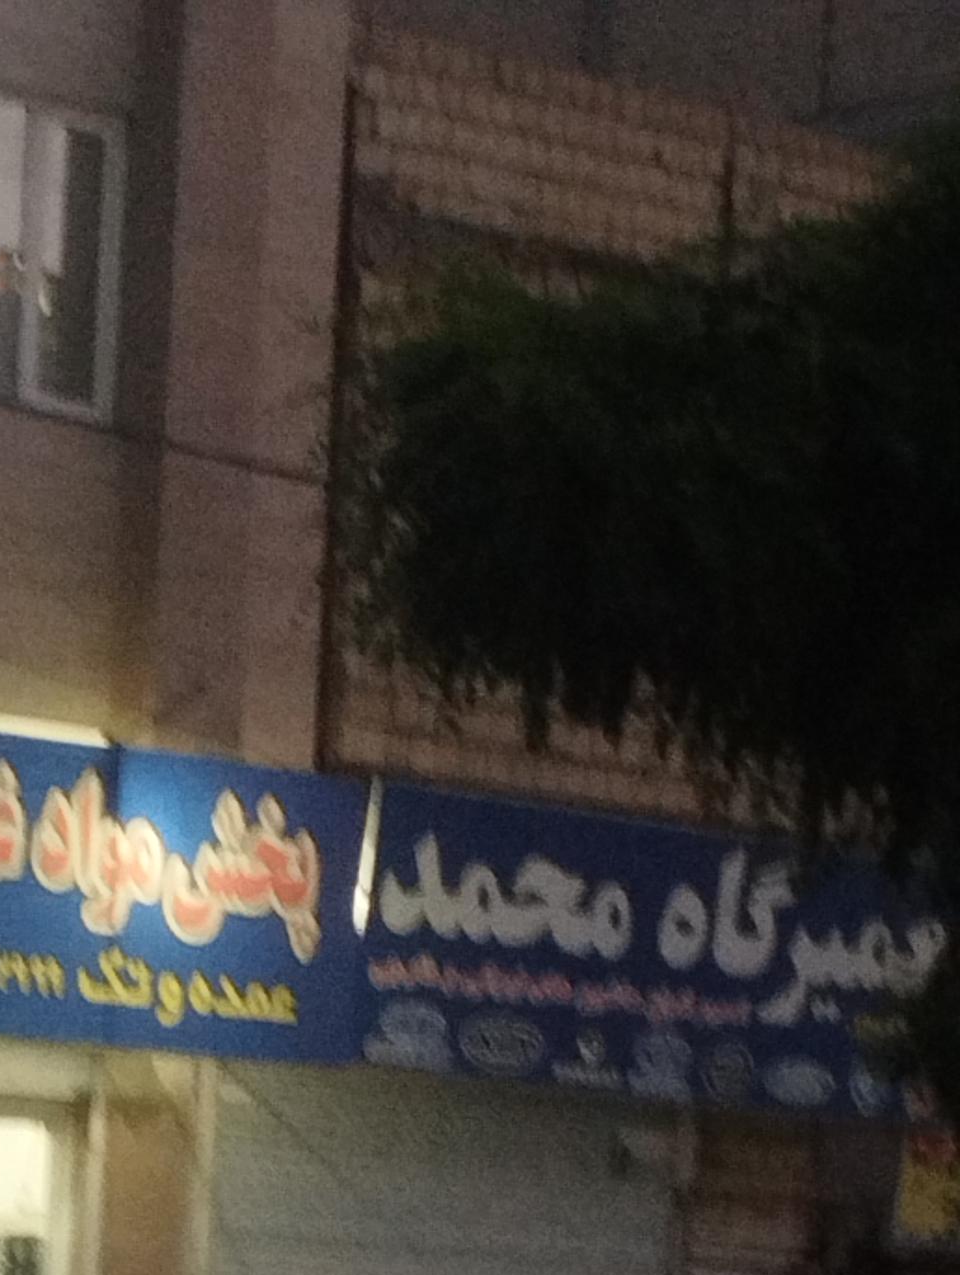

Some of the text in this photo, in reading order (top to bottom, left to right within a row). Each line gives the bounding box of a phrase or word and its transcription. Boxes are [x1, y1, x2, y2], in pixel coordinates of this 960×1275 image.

[32, 766, 167, 937] مواد
[161, 788, 323, 966] پخش
[377, 832, 633, 961] محمد
[77, 945, 153, 1009] تک
[155, 971, 186, 1027] و
[188, 970, 299, 1026] عمده
